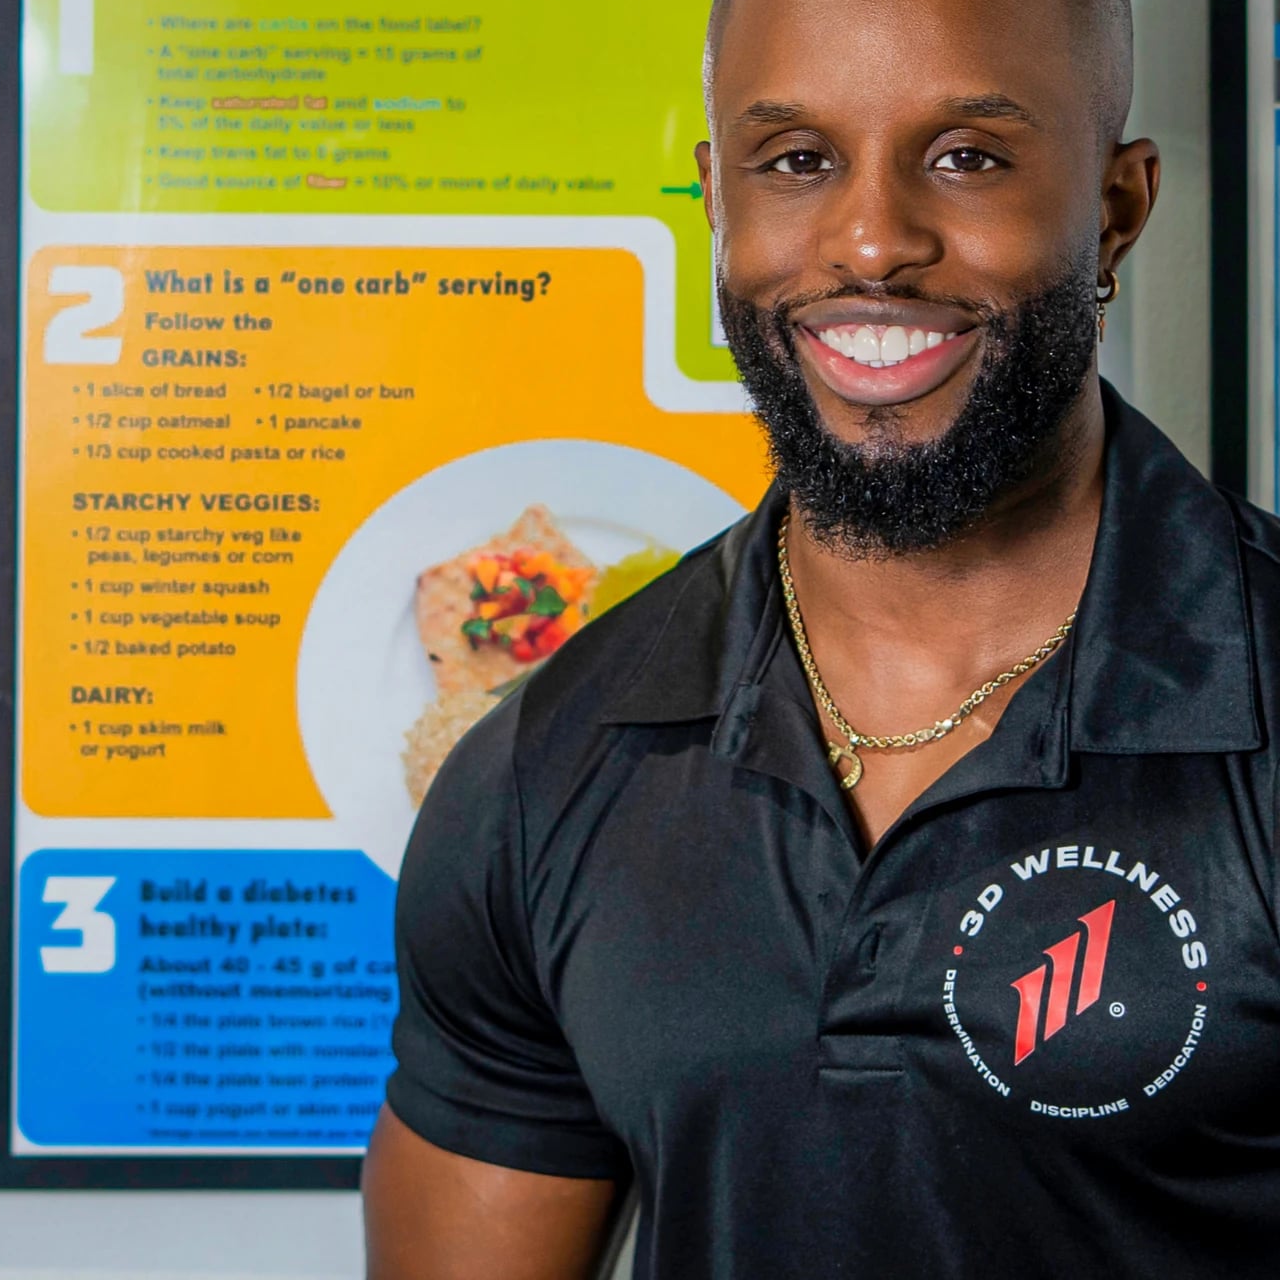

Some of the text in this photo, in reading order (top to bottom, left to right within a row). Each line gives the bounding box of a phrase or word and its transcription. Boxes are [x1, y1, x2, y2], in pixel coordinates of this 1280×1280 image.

[145, 270, 213, 294] What
[223, 270, 244, 294] is
[255, 277, 269, 294] a
[438, 271, 552, 302] serving?
[44, 265, 124, 364] 2
[145, 312, 272, 331] Follow the
[142, 349, 247, 368] GRAINS:
[102, 384, 144, 398] slice
[150, 384, 169, 398] of
[174, 383, 226, 398] bread
[268, 383, 415, 402] 1/2 bagel or bun
[87, 414, 230, 431] 1/2 cup oatmeal
[285, 414, 362, 431] pancake
[117, 447, 151, 462] cup
[157, 444, 224, 460] cooked
[230, 446, 280, 462] pasta
[287, 448, 305, 460] or
[312, 445, 345, 460] rice
[73, 493, 320, 512] STARCHY VEGGIES:
[86, 527, 302, 545] 1/2 cup starchy veg like
[88, 549, 293, 566] peas, legumes or corn
[100, 581, 133, 597] cup
[140, 580, 196, 594] winter
[202, 579, 269, 597] squash
[100, 612, 133, 627] cup
[140, 610, 229, 627] vegetable
[235, 613, 281, 628] soup
[84, 640, 236, 658] 1/2 baked potato
[71, 686, 154, 704] DAIRY:
[99, 723, 132, 738] cup
[139, 720, 182, 735] skim
[188, 720, 226, 735] milk
[81, 743, 166, 759] or yogurt
[141, 880, 356, 903] Build a diabetes
[960, 845, 1207, 970] 3D WELLNESS
[40, 876, 116, 973] 3
[140, 915, 328, 944] healthy plate:
[943, 969, 1207, 1118] DETERMINATION DISCIPLINE DEDICATION
